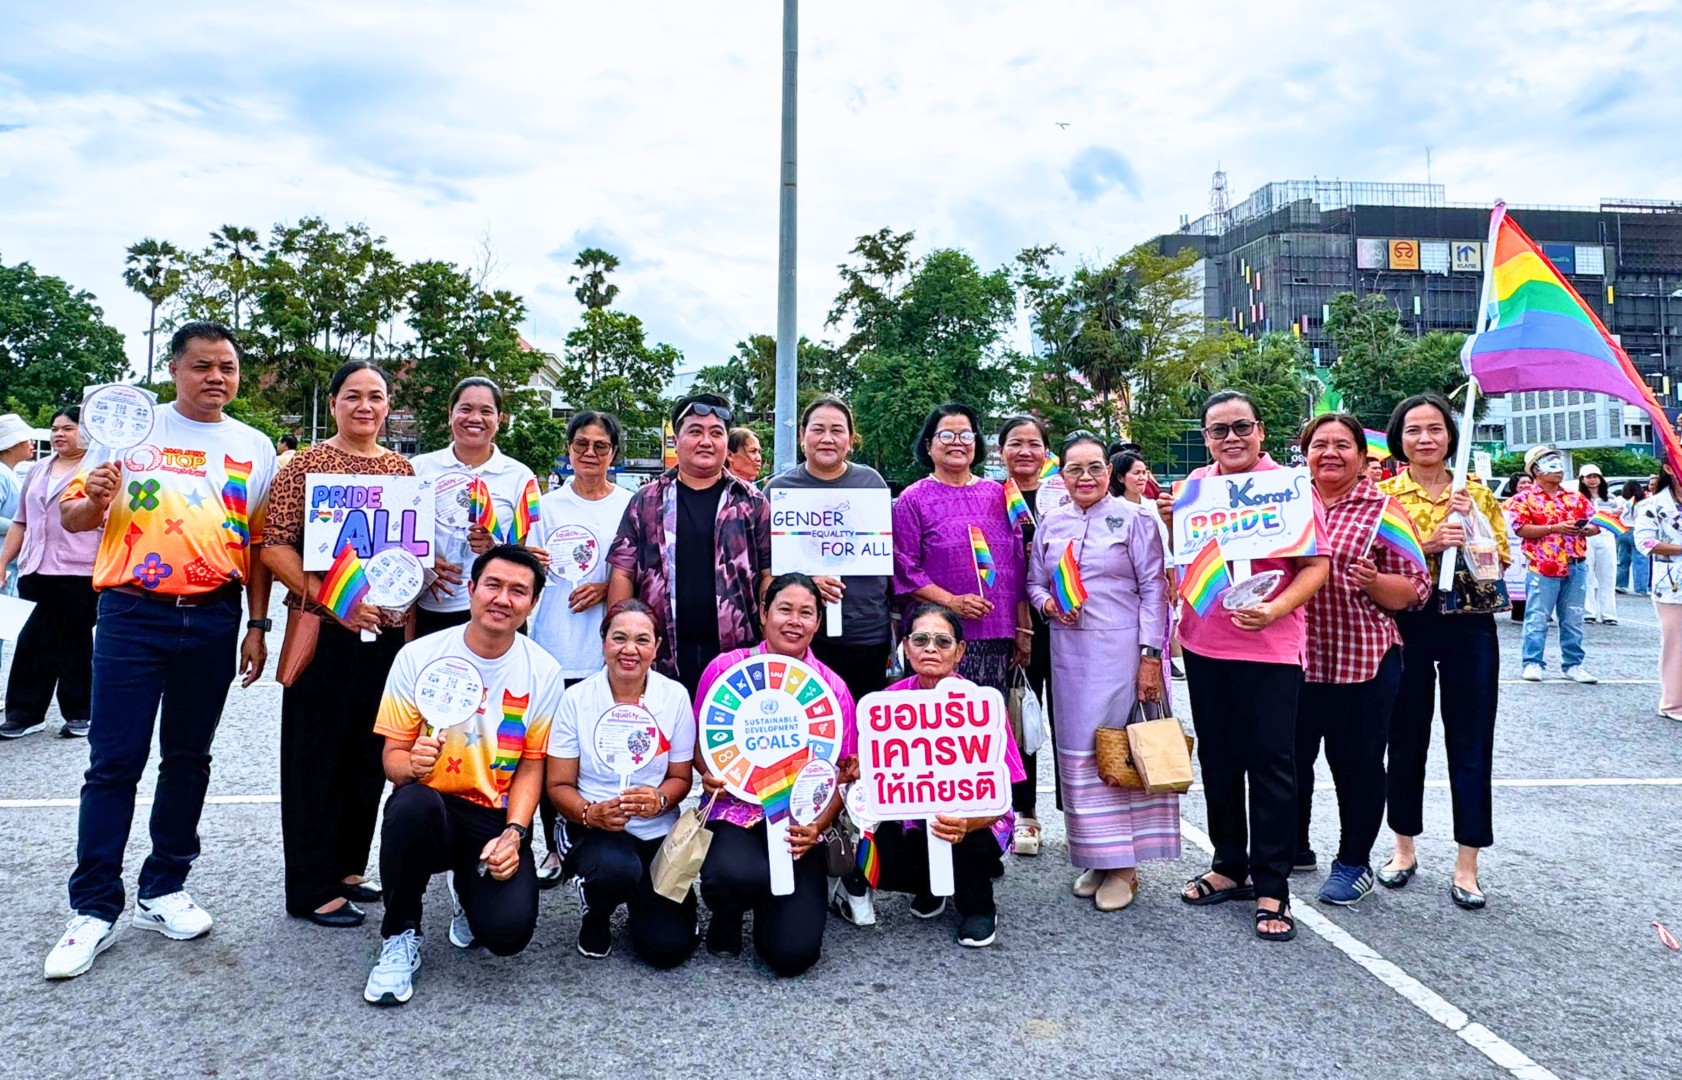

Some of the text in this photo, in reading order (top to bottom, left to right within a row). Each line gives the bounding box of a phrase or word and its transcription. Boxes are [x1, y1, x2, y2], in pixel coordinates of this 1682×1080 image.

[311, 485, 383, 509] PRIDE
[1226, 477, 1297, 508] Korat
[773, 510, 845, 527] GENDER
[1190, 505, 1281, 539] PRIDE
[332, 509, 430, 559] ALL
[811, 529, 855, 539] EQUALITY
[821, 541, 891, 557] FOR ALL
[611, 710, 639, 720] Equality
[744, 715, 799, 727] SUSTAINABLE
[869, 691, 990, 732] ยอมรับ
[744, 723, 799, 735] DEVELOPMENT
[745, 733, 801, 751] GOALS
[871, 734, 992, 769] เคารพ
[872, 770, 996, 804] ให้เกียรติ
